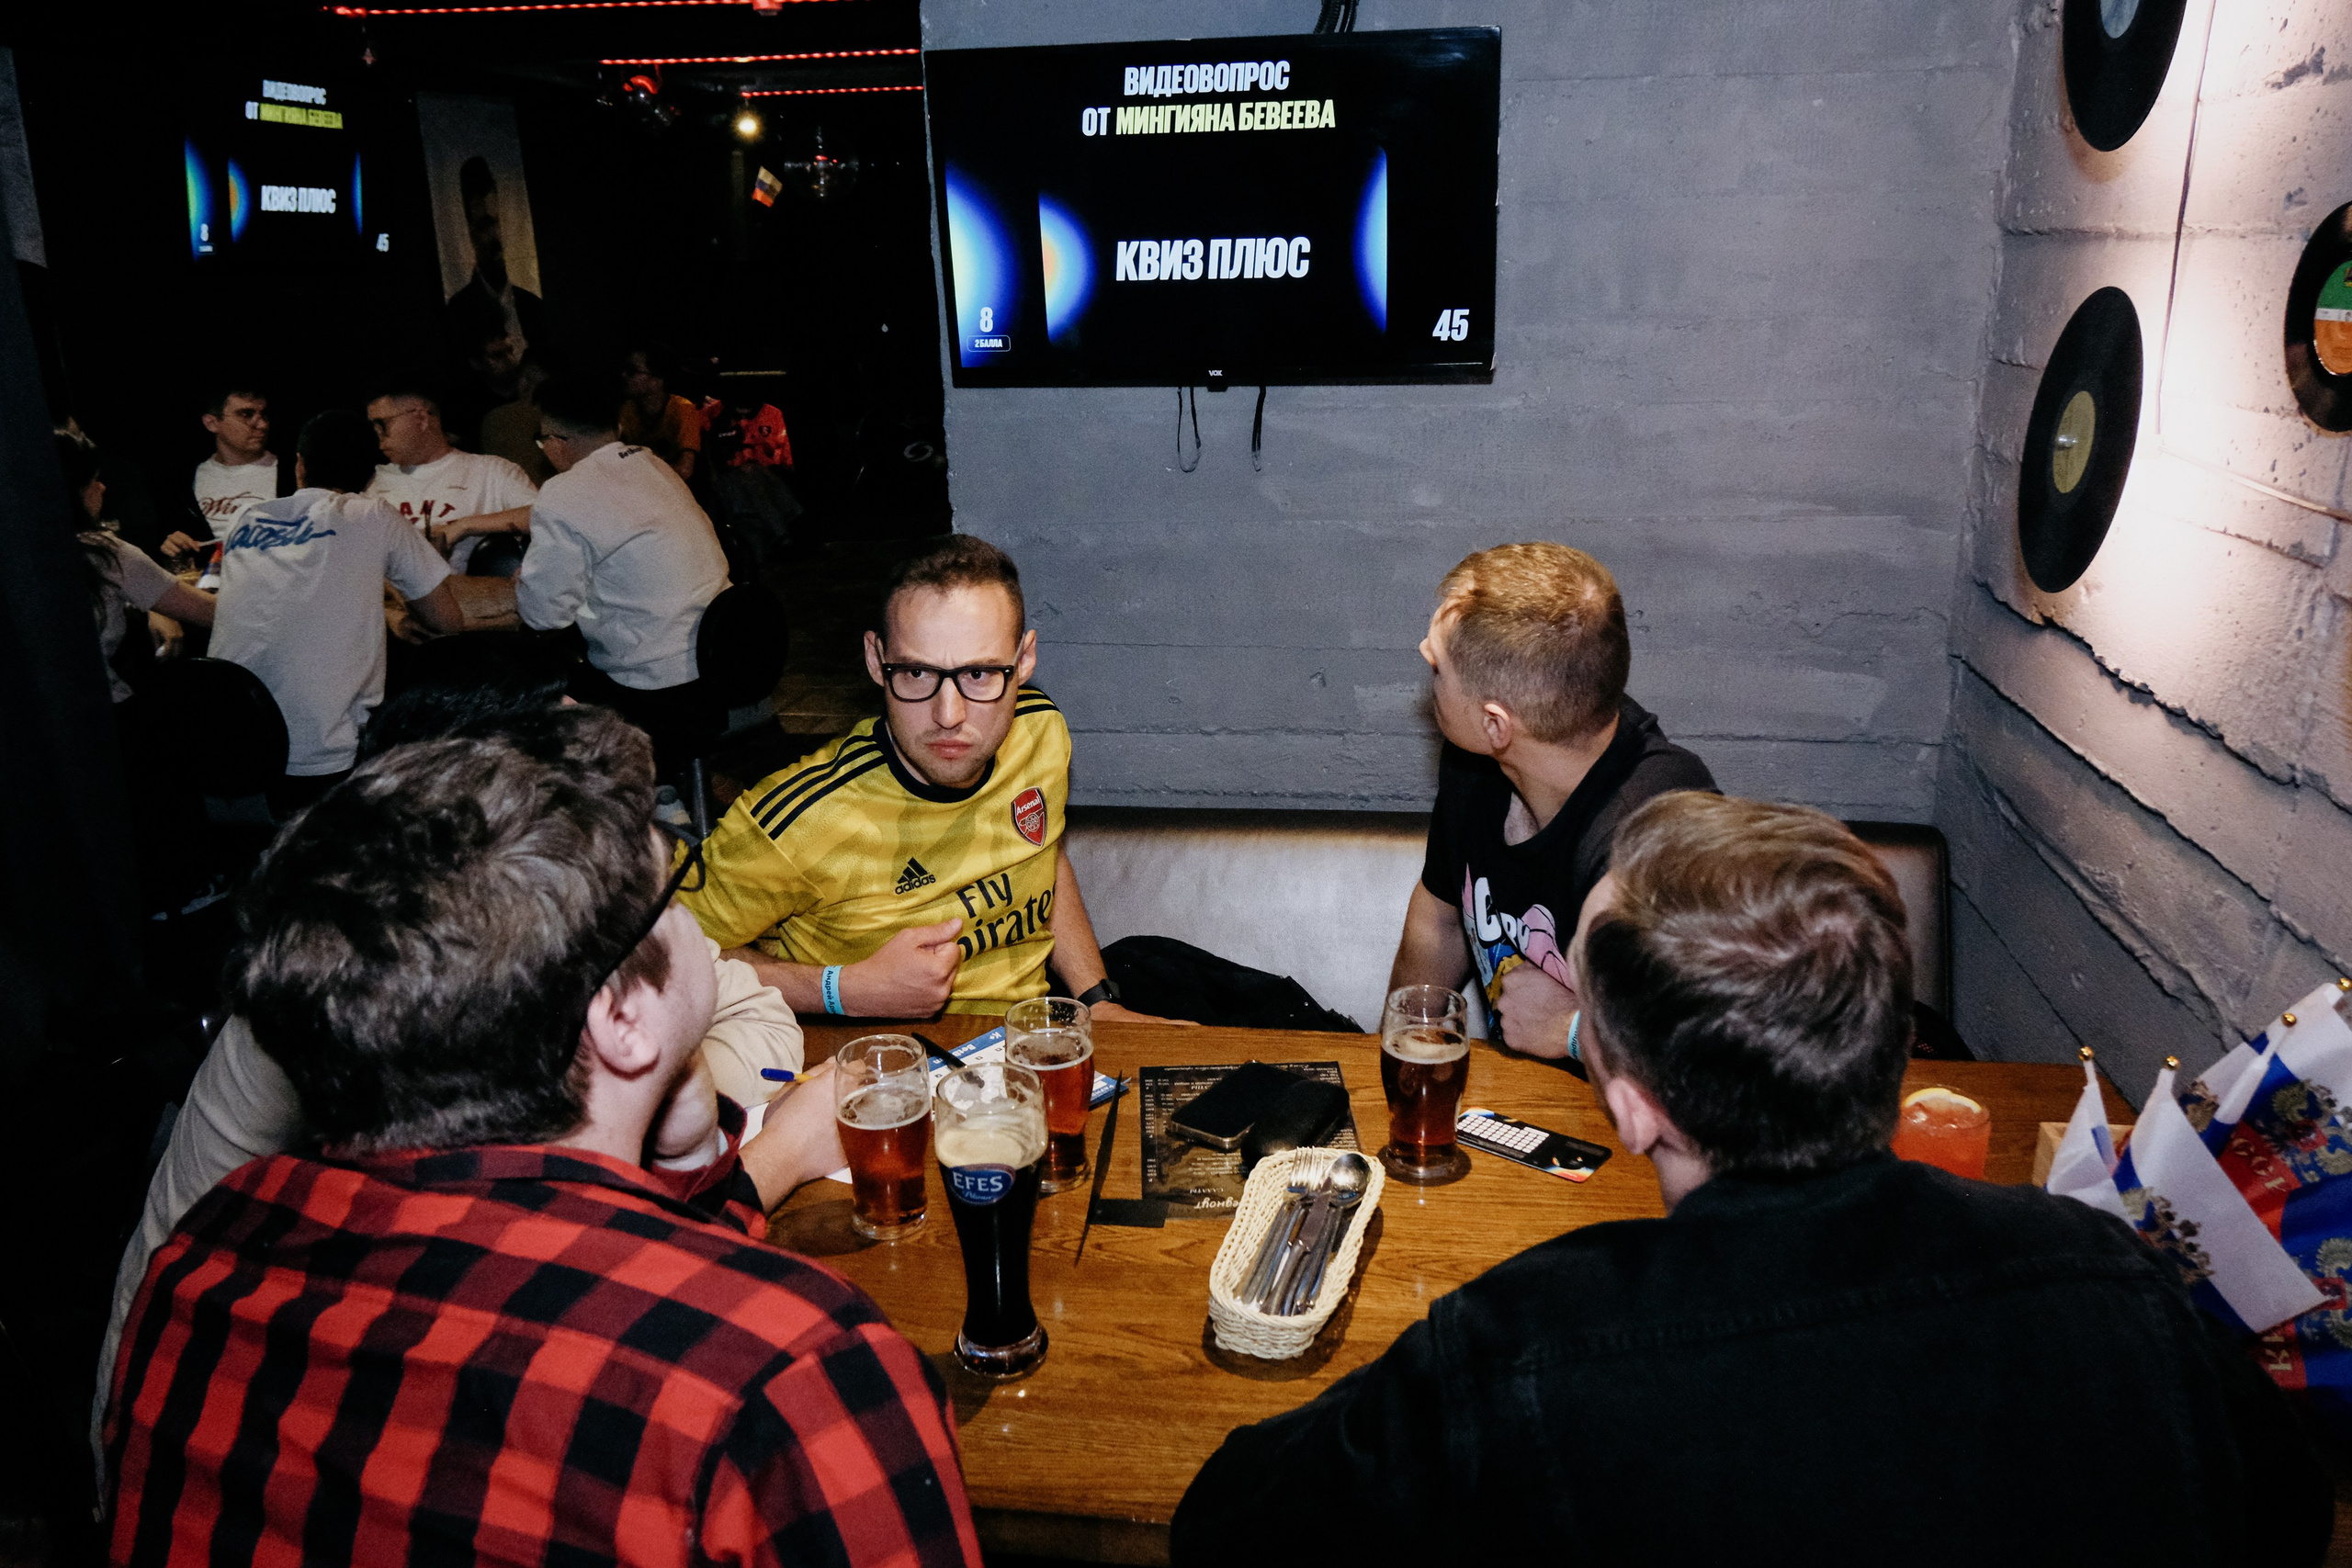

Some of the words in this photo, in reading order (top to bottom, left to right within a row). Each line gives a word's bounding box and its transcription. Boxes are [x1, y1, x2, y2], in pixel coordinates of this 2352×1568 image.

[1124, 60, 1291, 98] ВИДЕОВОПРОС
[1081, 107, 1111, 137] ОТ
[1115, 102, 1236, 135] МИНГИЯНА
[1238, 99, 1336, 131] БЕВЕЕВА
[1115, 239, 1204, 282] КВИЗ
[1207, 237, 1311, 280] ПЛЮС
[979, 307, 993, 333] 8
[1432, 309, 1470, 342] 45
[975, 339, 980, 348] 2
[1015, 795, 1043, 816] Arsenal
[895, 872, 937, 896] adidas
[956, 873, 1013, 919] Fly
[952, 1171, 1003, 1192] EFES
